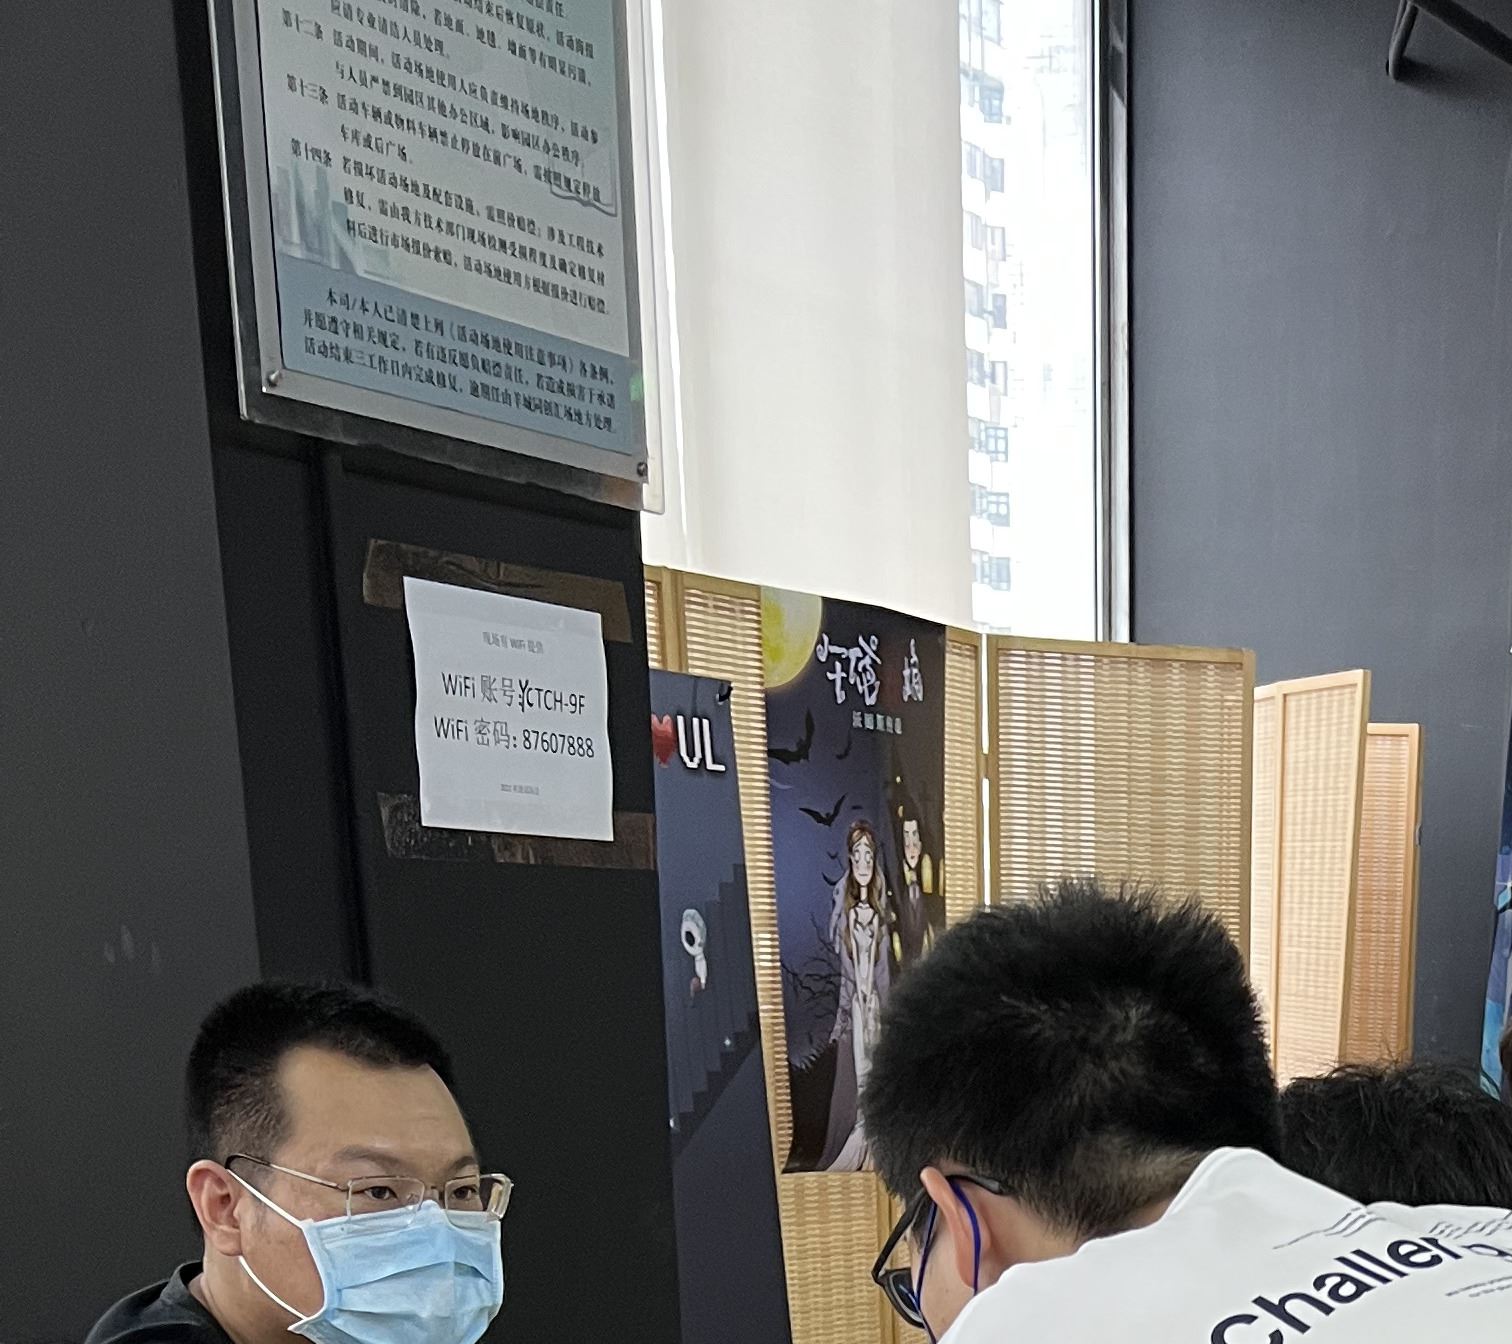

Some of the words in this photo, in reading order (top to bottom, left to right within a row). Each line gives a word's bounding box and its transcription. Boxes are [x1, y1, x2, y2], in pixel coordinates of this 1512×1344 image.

[281, 7, 323, 41] 第十二条
[286, 73, 328, 106] 第十三条
[290, 137, 332, 168] 第十四条
[441, 671, 476, 699] WiFi
[434, 715, 469, 742] WiFi
[523, 729, 595, 758] 87607888
